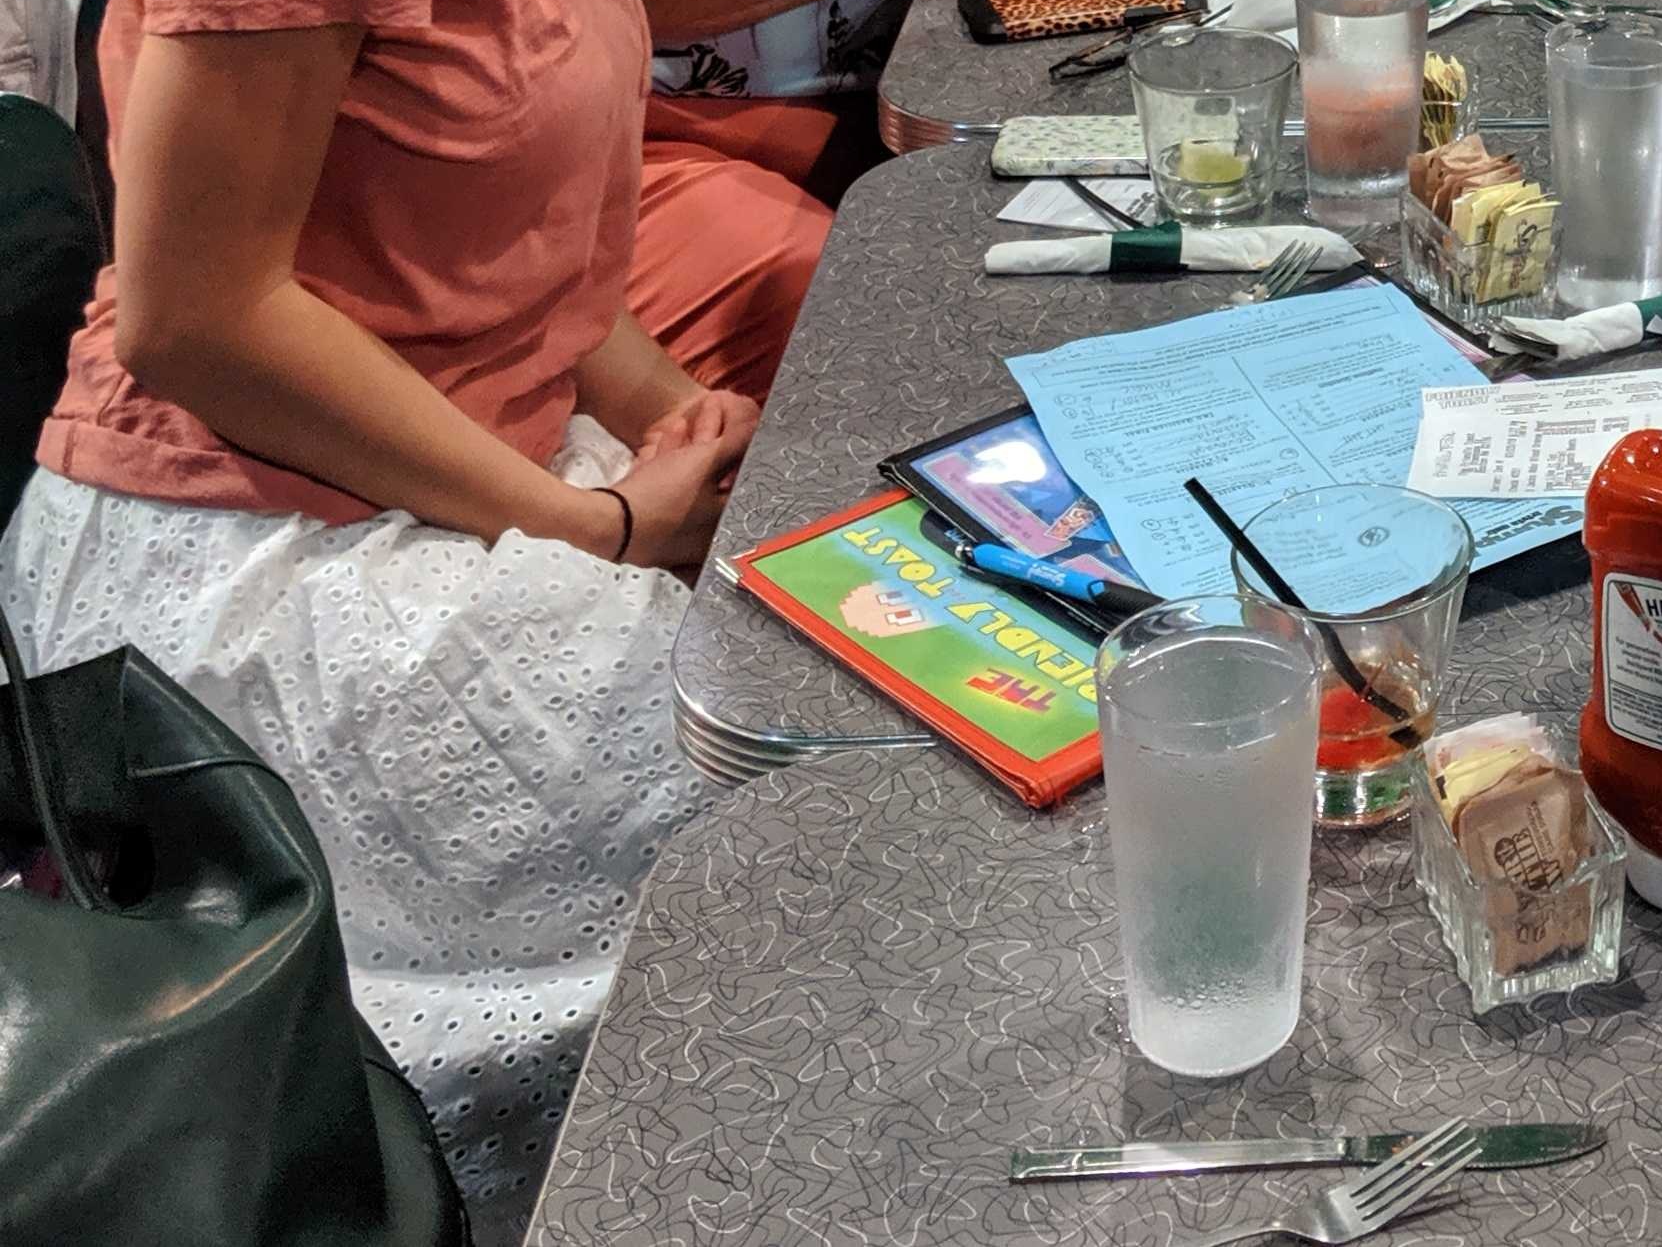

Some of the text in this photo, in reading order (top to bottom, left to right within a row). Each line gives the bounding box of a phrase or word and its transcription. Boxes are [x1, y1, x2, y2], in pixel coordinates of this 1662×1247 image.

[840, 526, 954, 600] TOAST
[945, 601, 1098, 705] RIENDLY
[965, 666, 1058, 715] THE
